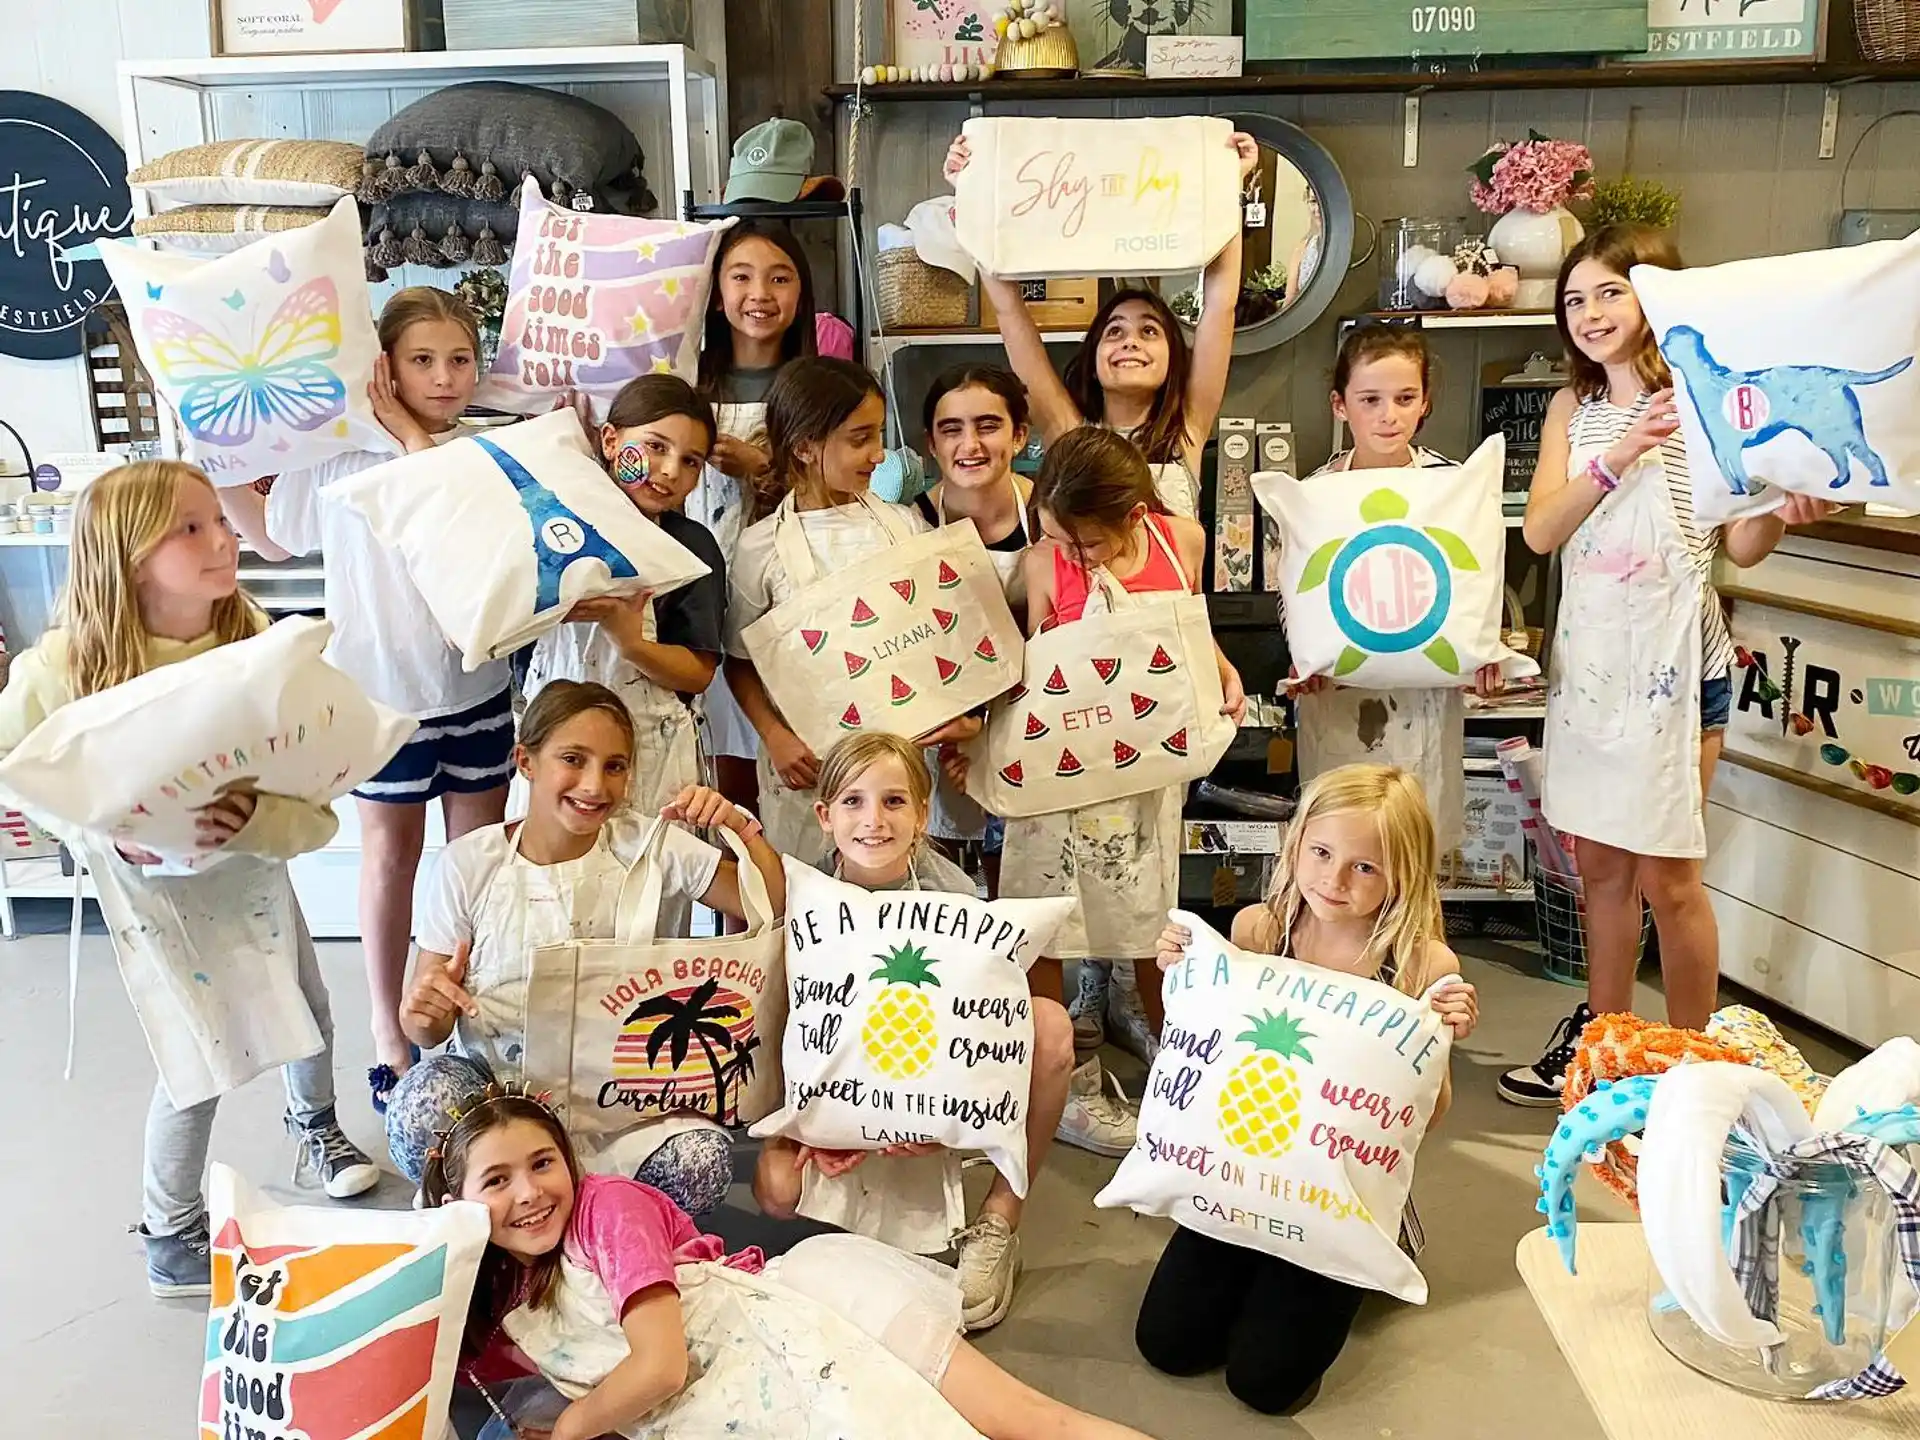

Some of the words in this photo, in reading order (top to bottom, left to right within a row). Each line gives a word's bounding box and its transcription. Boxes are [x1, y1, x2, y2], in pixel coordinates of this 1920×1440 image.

[1411, 7, 1476, 33] 07090
[944, 45, 996, 66] LIA
[1012, 151, 1094, 238] Slay
[534, 242, 580, 279] the
[1114, 233, 1179, 253] ROSIE
[528, 284, 591, 319] good
[522, 316, 600, 360] times
[523, 358, 576, 387] roll
[1500, 418, 1545, 441] STIC
[549, 523, 579, 548] R
[1347, 548, 1431, 629] MJE
[872, 622, 936, 660] LIYANA
[1062, 704, 1112, 732] ETB
[789, 908, 822, 951] BE
[839, 901, 855, 935] A
[600, 967, 663, 1017] HOLA
[673, 956, 767, 995] BEACHES
[793, 972, 858, 1010] stand
[798, 1013, 842, 1055] tall
[1213, 953, 1230, 987] A
[1257, 966, 1440, 1076] PINEAPPLE
[949, 1036, 1028, 1068] crown
[1160, 1019, 1223, 1066] tand
[797, 1077, 866, 1112] sweet
[872, 1089, 893, 1112] ON
[906, 1094, 936, 1117] THE
[943, 1090, 1019, 1130] inside
[1153, 1065, 1202, 1111] tall
[1145, 1131, 1216, 1177] sweet
[1221, 1160, 1245, 1188] ON
[1258, 1171, 1292, 1202] THE
[1309, 1122, 1400, 1173] crown
[1193, 1195, 1305, 1243] CARTER
[224, 1306, 268, 1362] the
[224, 1366, 285, 1421] good
